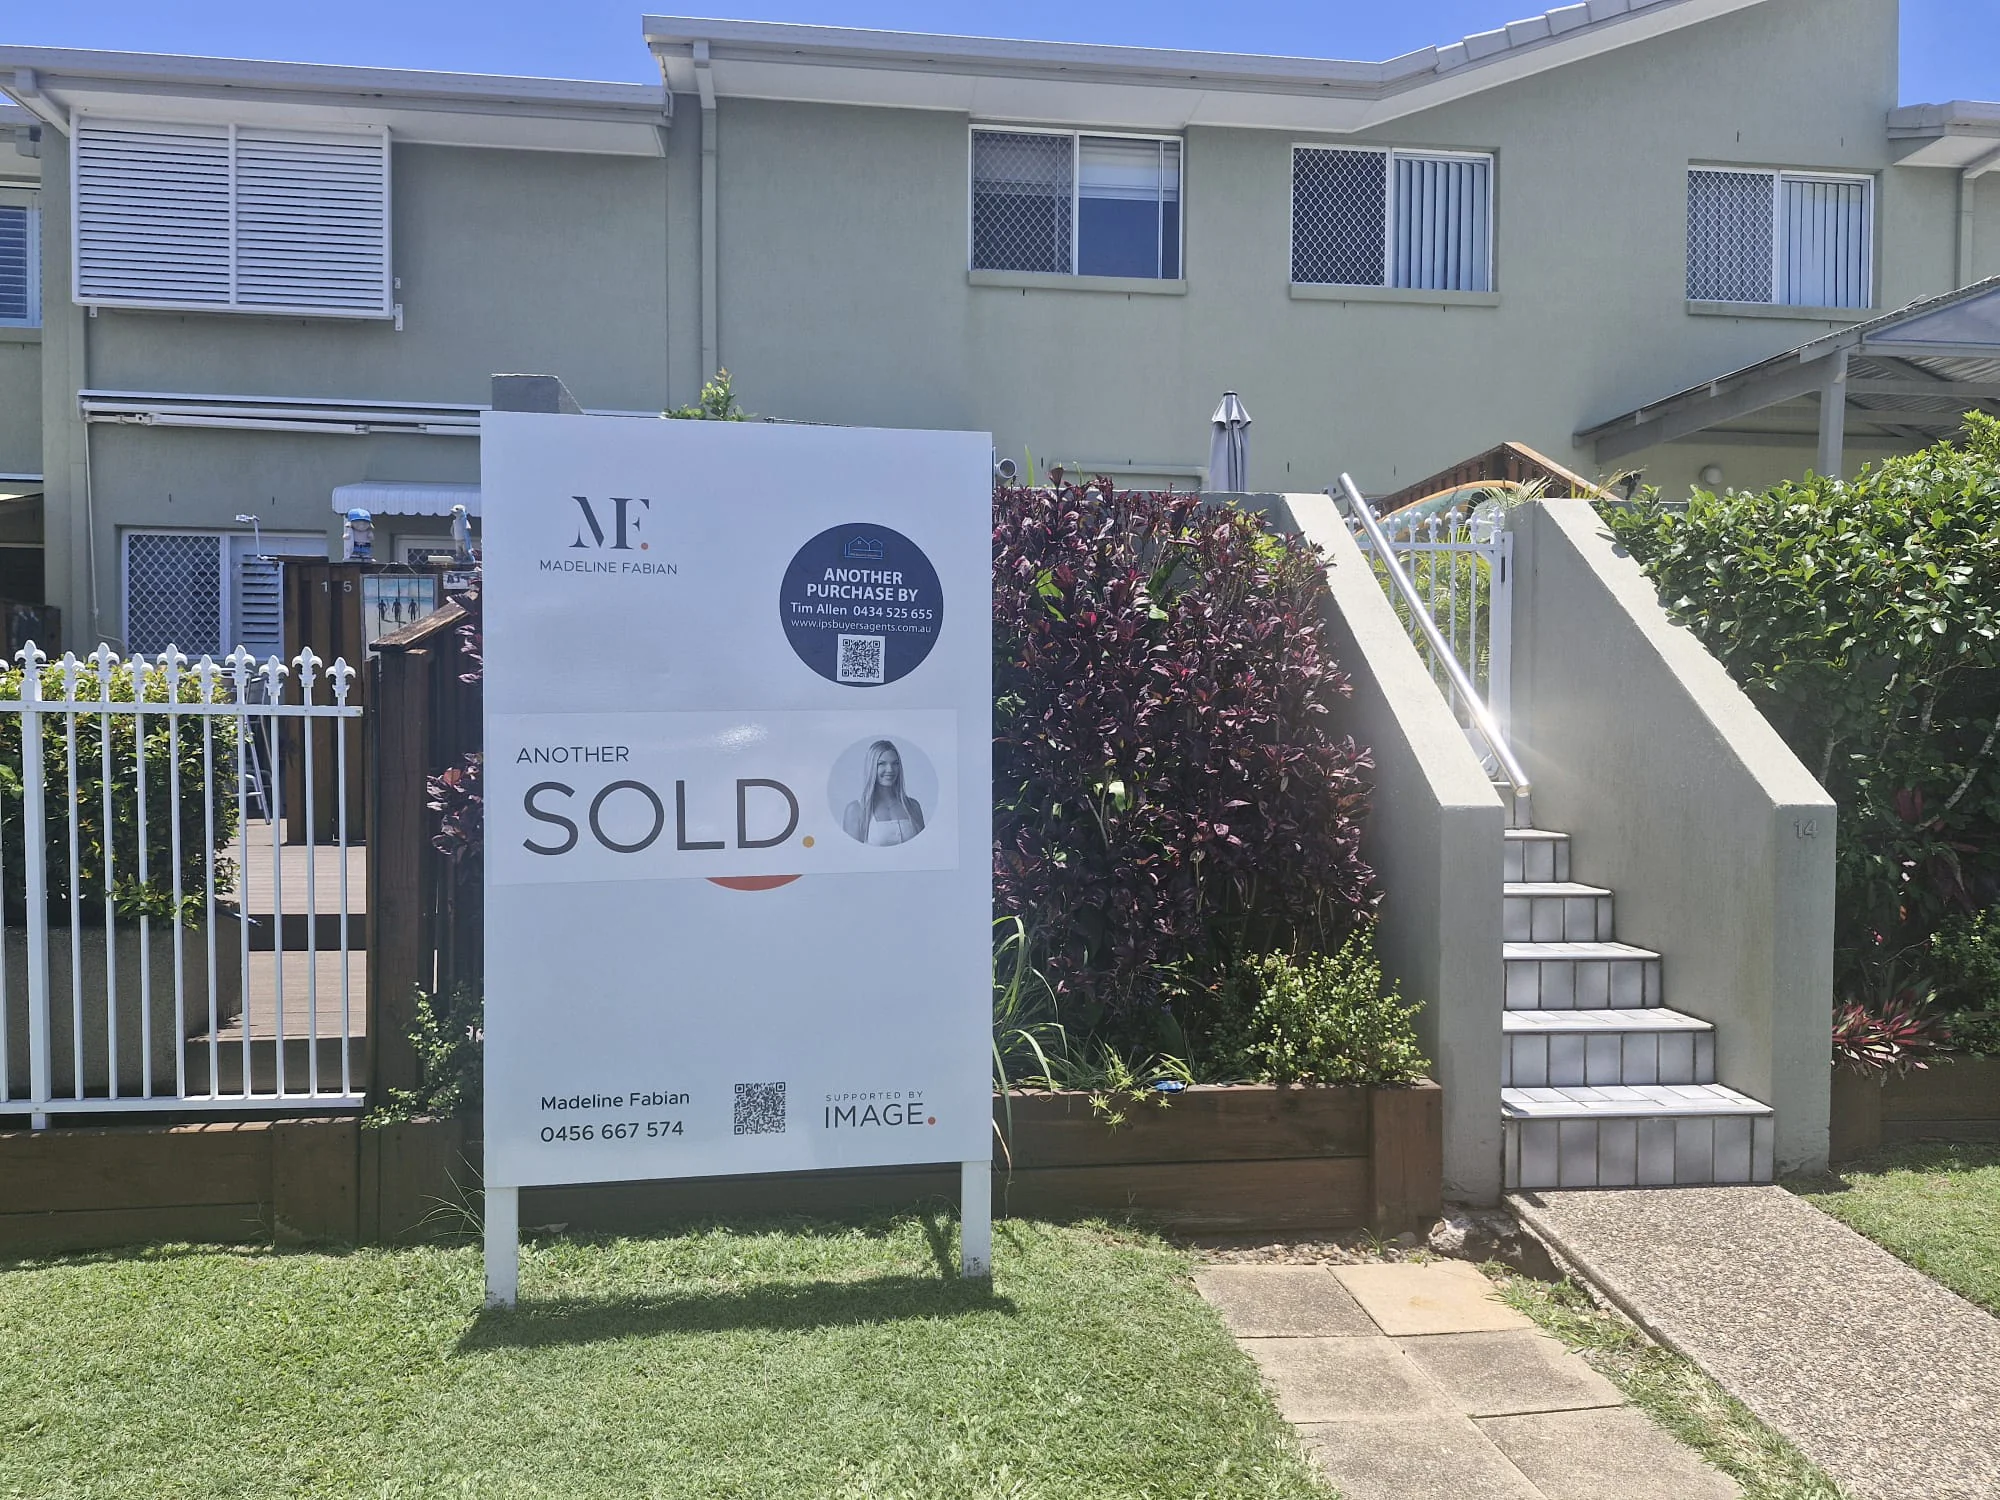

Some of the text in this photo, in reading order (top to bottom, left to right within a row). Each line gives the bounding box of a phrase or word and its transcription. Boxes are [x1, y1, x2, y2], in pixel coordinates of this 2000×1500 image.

[540, 560, 678, 575] MADELINE FABIAN
[823, 567, 903, 585] ANOTHER
[806, 583, 919, 602] PURCHASE BY
[790, 602, 933, 620] Tim Allen 0434 525 655
[791, 619, 932, 633] www.ipsbuyersagents.com.au
[516, 746, 630, 763] ANOTHER
[522, 778, 815, 855] SOLD.
[1793, 819, 1818, 839] 14
[541, 1091, 690, 1110] Madeline Fabian
[825, 1090, 923, 1102] SUPPORTED BY
[825, 1102, 937, 1129] IMAGE.
[540, 1121, 684, 1142] 0456 667 574
